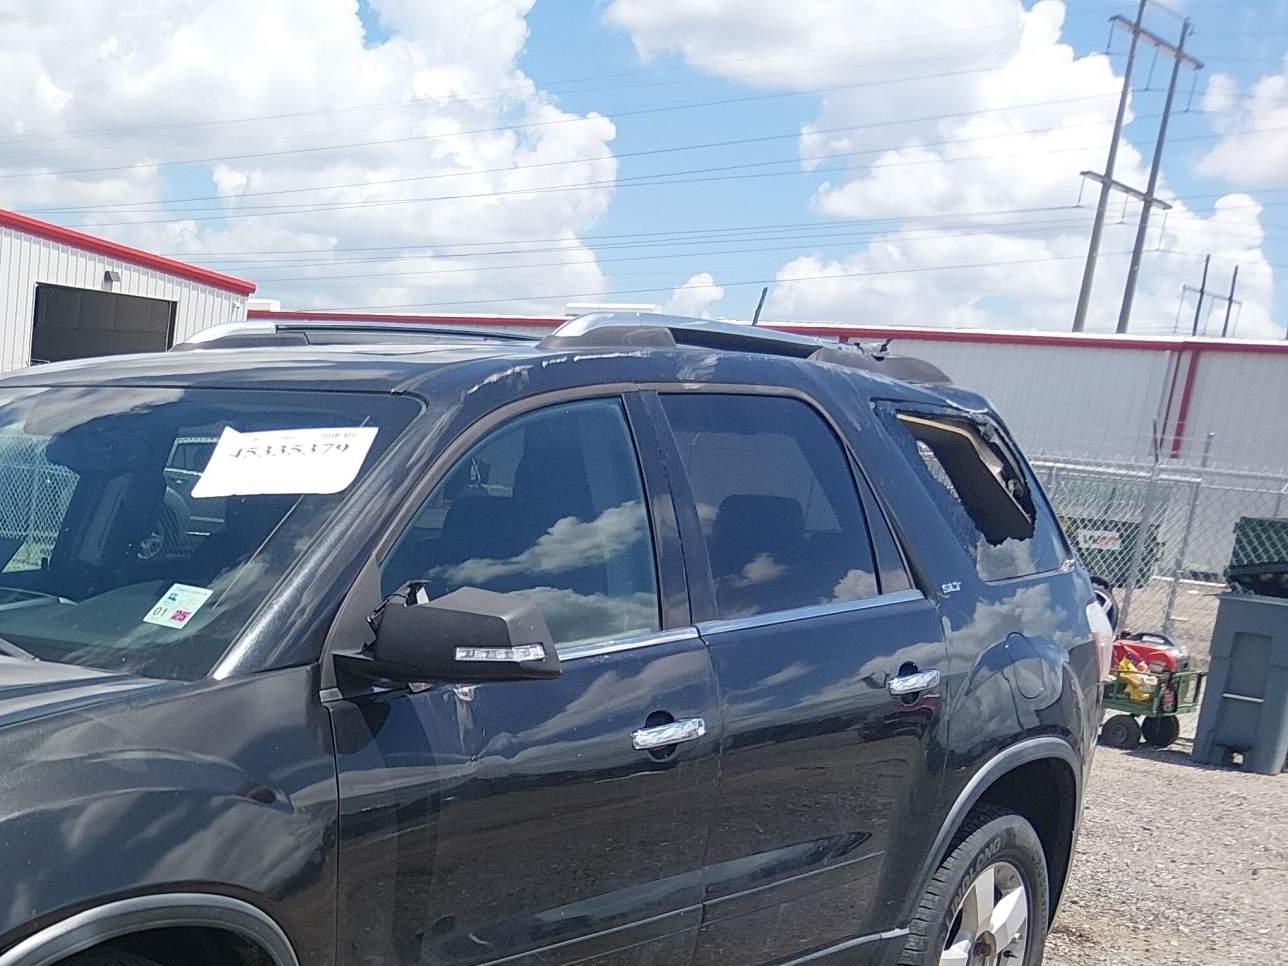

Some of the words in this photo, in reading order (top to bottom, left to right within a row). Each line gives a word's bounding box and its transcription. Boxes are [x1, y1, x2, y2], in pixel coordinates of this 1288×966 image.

[941, 581, 961, 593] SLT
[152, 606, 169, 618] 01
[171, 609, 192, 622] 25
